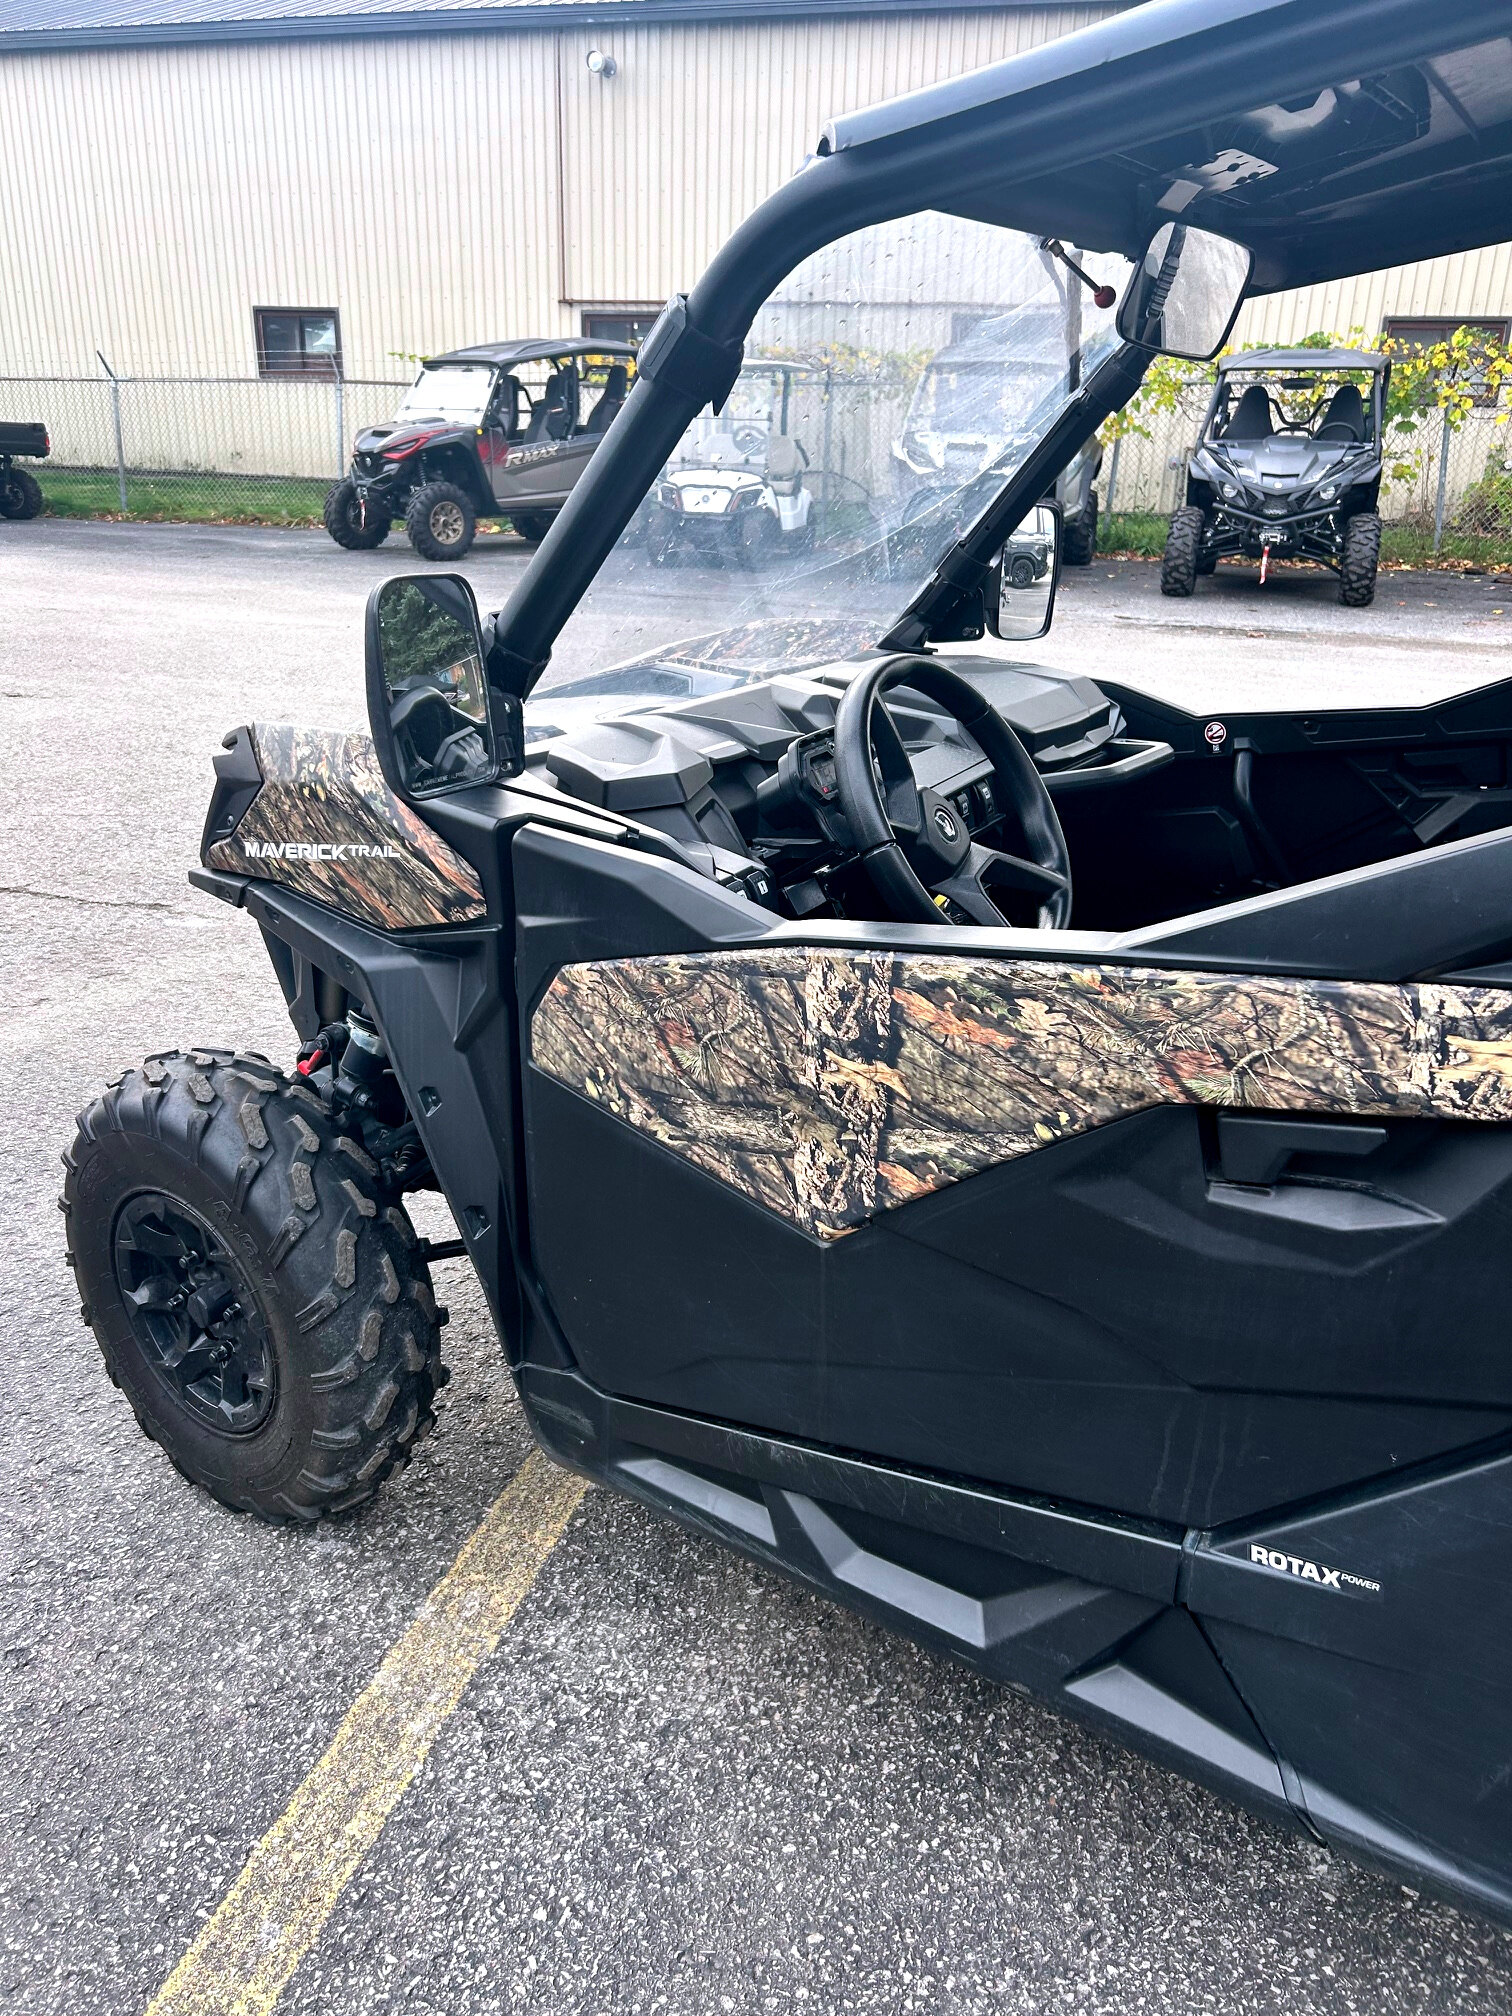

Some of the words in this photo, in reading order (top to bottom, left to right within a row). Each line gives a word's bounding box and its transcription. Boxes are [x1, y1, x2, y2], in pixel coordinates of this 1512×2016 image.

[505, 443, 560, 468] RMAX
[244, 841, 348, 861] MAVERICK
[347, 844, 401, 858] TRAIL
[1250, 1544, 1341, 1588] ROTAX
[1340, 1573, 1381, 1591] POWER
